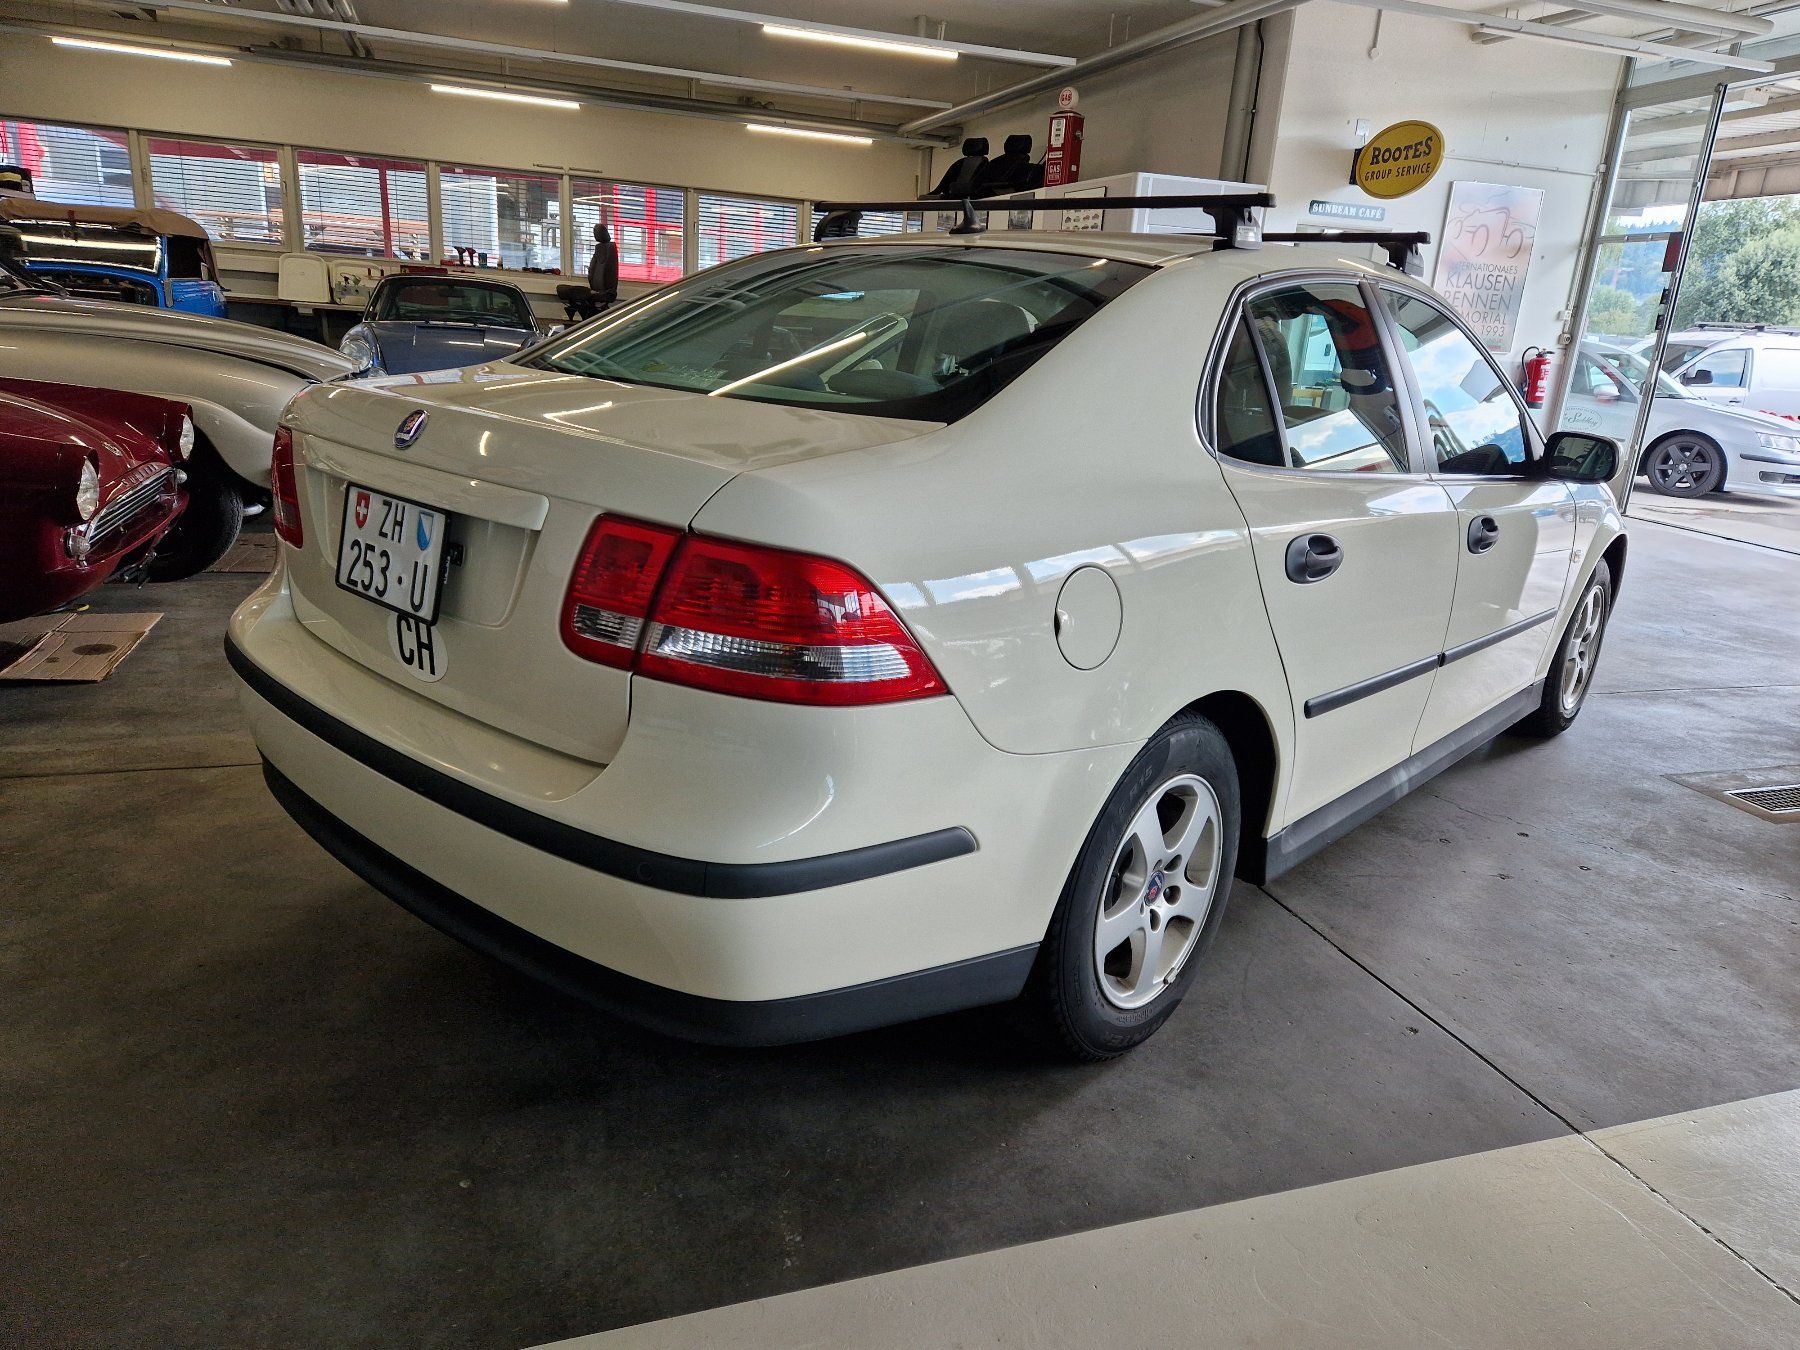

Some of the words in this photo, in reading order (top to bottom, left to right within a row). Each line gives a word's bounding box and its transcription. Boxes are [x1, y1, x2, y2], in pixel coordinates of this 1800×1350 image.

[1061, 93, 1072, 102] GAS
[1370, 136, 1432, 166] ROOTES
[1049, 164, 1060, 174] GAS
[1364, 169, 1392, 181] GROUP
[1395, 163, 1431, 177] SERVICE
[1312, 202, 1356, 216] SUNBEAM
[1359, 207, 1382, 219] CAFÉ
[1446, 271, 1516, 292] KLAUSEN
[1461, 310, 1507, 326] MORIAL
[1481, 324, 1505, 338] 1993
[379, 499, 405, 543] ZH
[396, 613, 435, 675] CH
